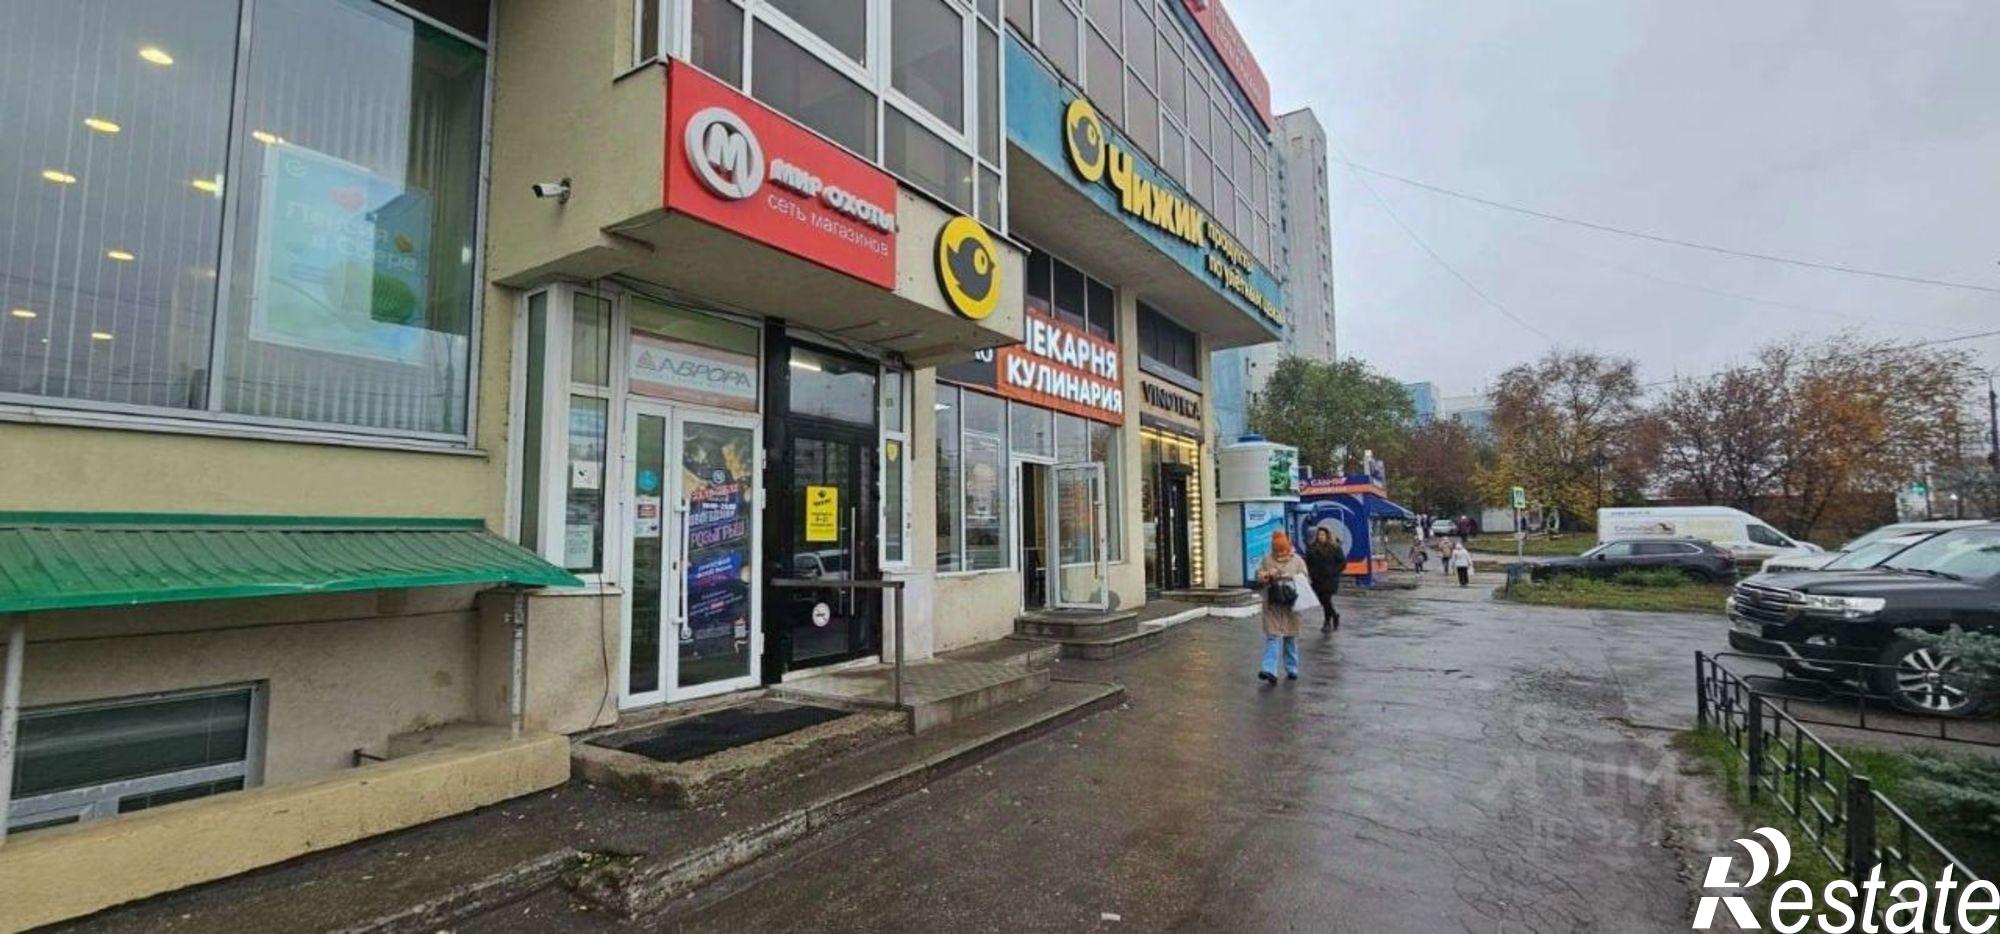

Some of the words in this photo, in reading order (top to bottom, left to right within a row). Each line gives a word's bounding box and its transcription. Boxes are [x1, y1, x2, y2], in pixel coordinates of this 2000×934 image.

[768, 194, 806, 222] сеть
[811, 211, 889, 257] магазинов
[658, 357, 751, 389] АВРОРА
[1006, 353, 1123, 414] КУЛИНАРИЯ
[1141, 380, 1201, 421] VINOTECA
